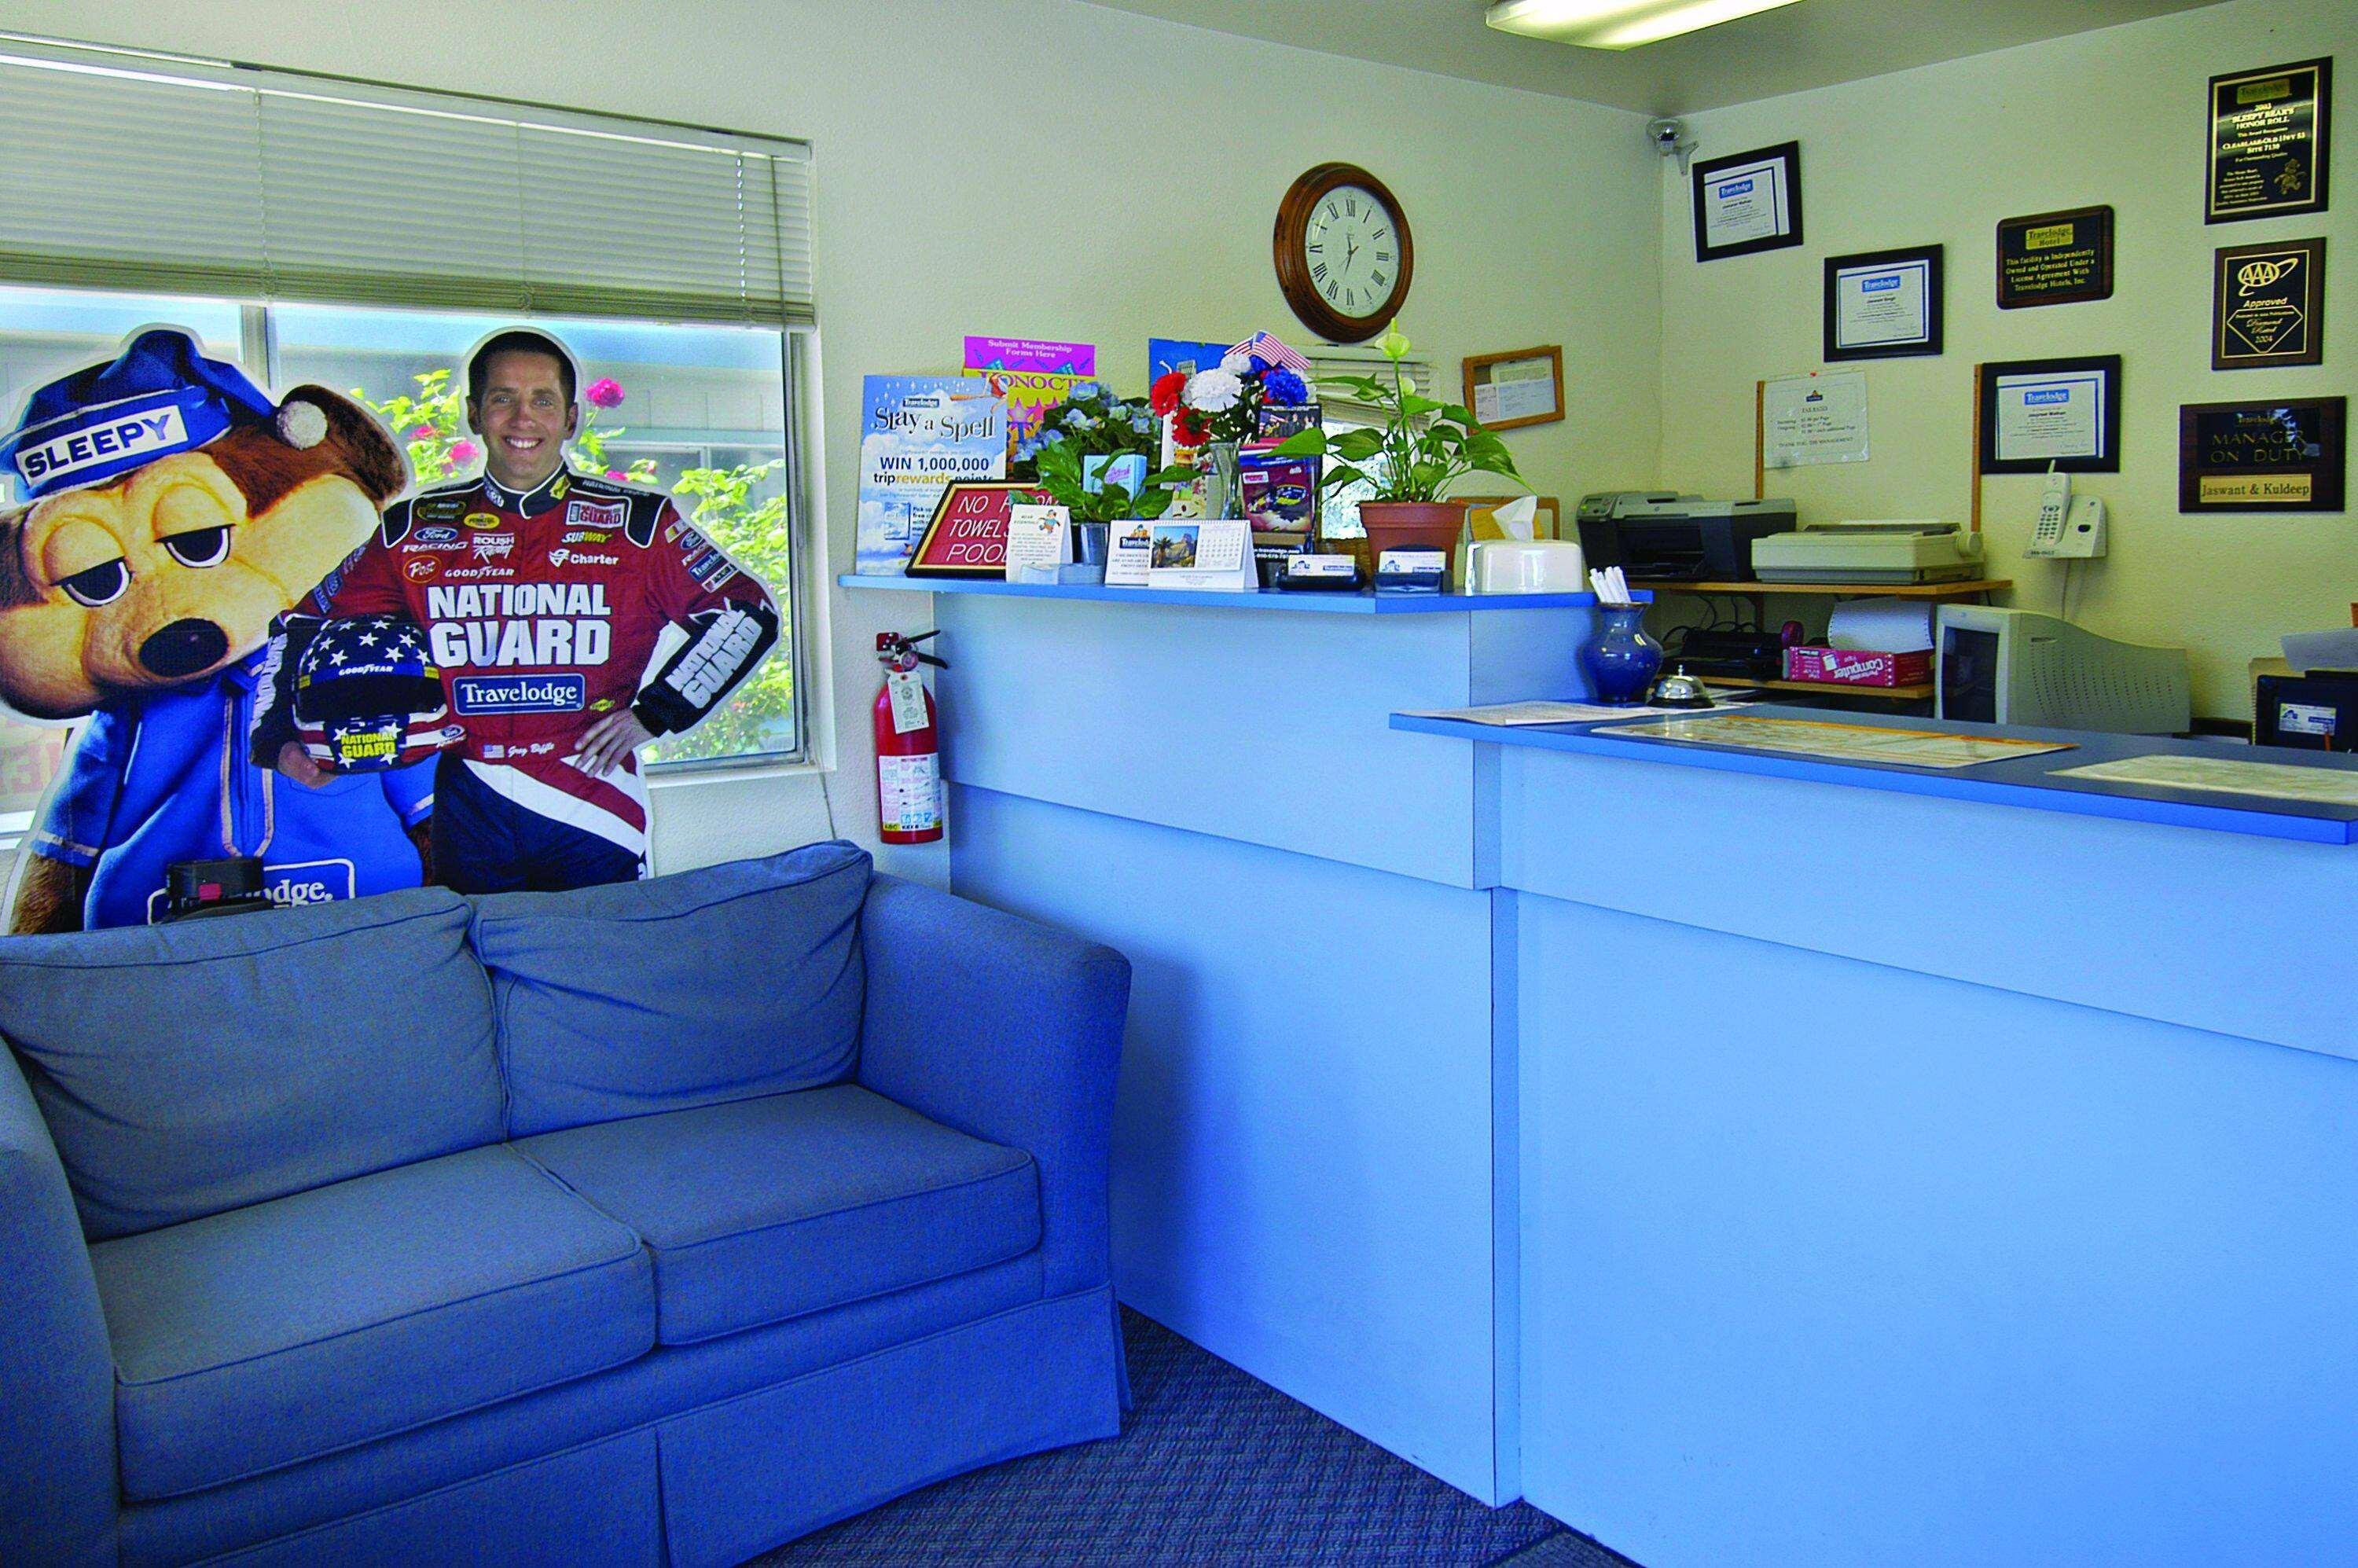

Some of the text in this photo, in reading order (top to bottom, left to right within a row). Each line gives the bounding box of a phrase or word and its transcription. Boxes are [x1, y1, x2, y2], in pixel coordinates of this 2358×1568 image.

[2243, 264, 2274, 281] AAA
[2243, 297, 2287, 308] Approved
[988, 340, 1072, 353] Submit Membership
[1006, 348, 1056, 358] Forms Here
[875, 406, 996, 442] Stay a Spell
[24, 413, 173, 478] SLEEPY
[2210, 448, 2304, 463] ON DUTY
[880, 457, 990, 472] WIN 1,000,000
[873, 472, 952, 486] triprewards
[2202, 483, 2309, 497] Jaswant & Kuldeep
[958, 496, 989, 513] NO
[580, 512, 621, 524] GUARD
[422, 528, 451, 540] Ford
[949, 519, 1009, 538] TOWEL
[473, 536, 514, 545] ROUSH
[561, 531, 613, 543] SUBWAY
[402, 542, 468, 553] RACING
[946, 543, 1007, 563] POO
[571, 553, 619, 565] Charter
[410, 562, 435, 578] Post
[428, 583, 612, 620] NATIONAL
[432, 619, 612, 668] GUARD
[665, 609, 747, 692] NATIONAL
[681, 616, 762, 709] GUARD
[1834, 658, 1883, 678] Computer
[461, 683, 578, 706] Travelodge
[340, 733, 395, 744] NATIONAL
[341, 742, 395, 758] GUARD
